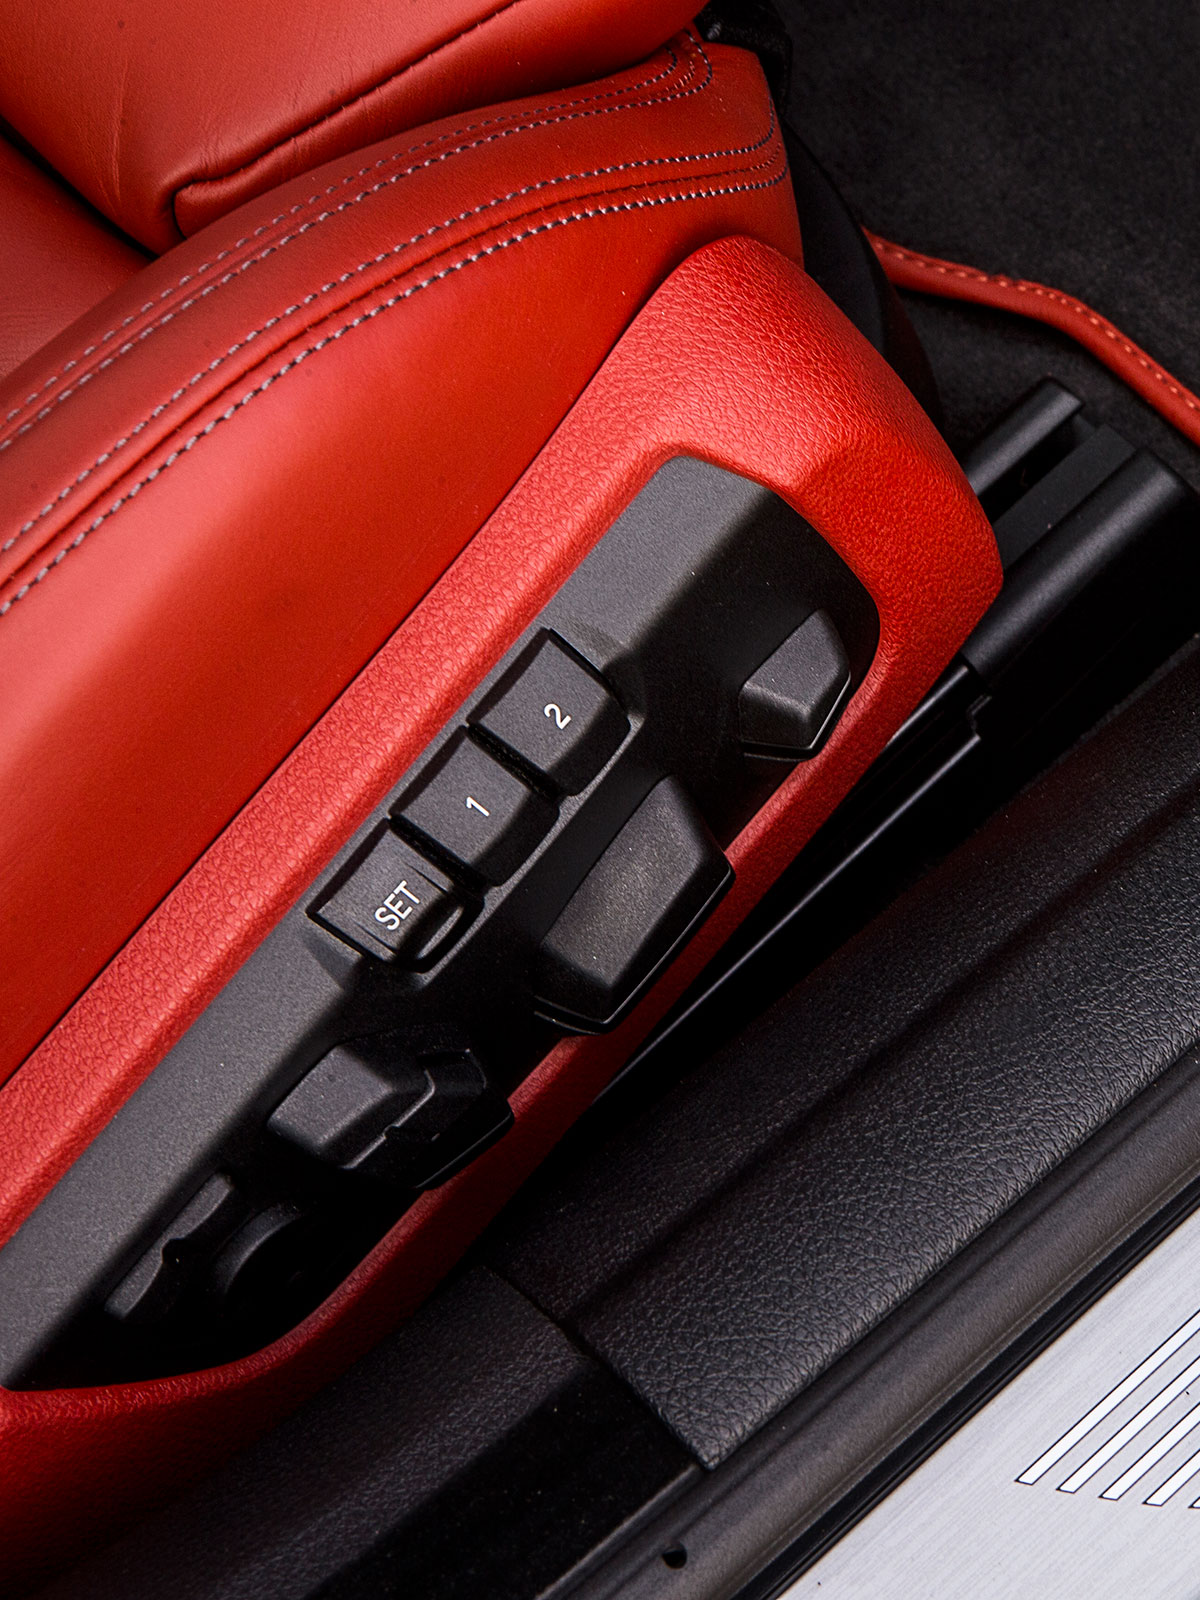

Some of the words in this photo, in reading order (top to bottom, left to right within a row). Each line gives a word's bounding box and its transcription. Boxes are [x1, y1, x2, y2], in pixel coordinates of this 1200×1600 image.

[543, 703, 572, 730] 2
[465, 796, 490, 817] 1
[374, 880, 420, 930] SET
